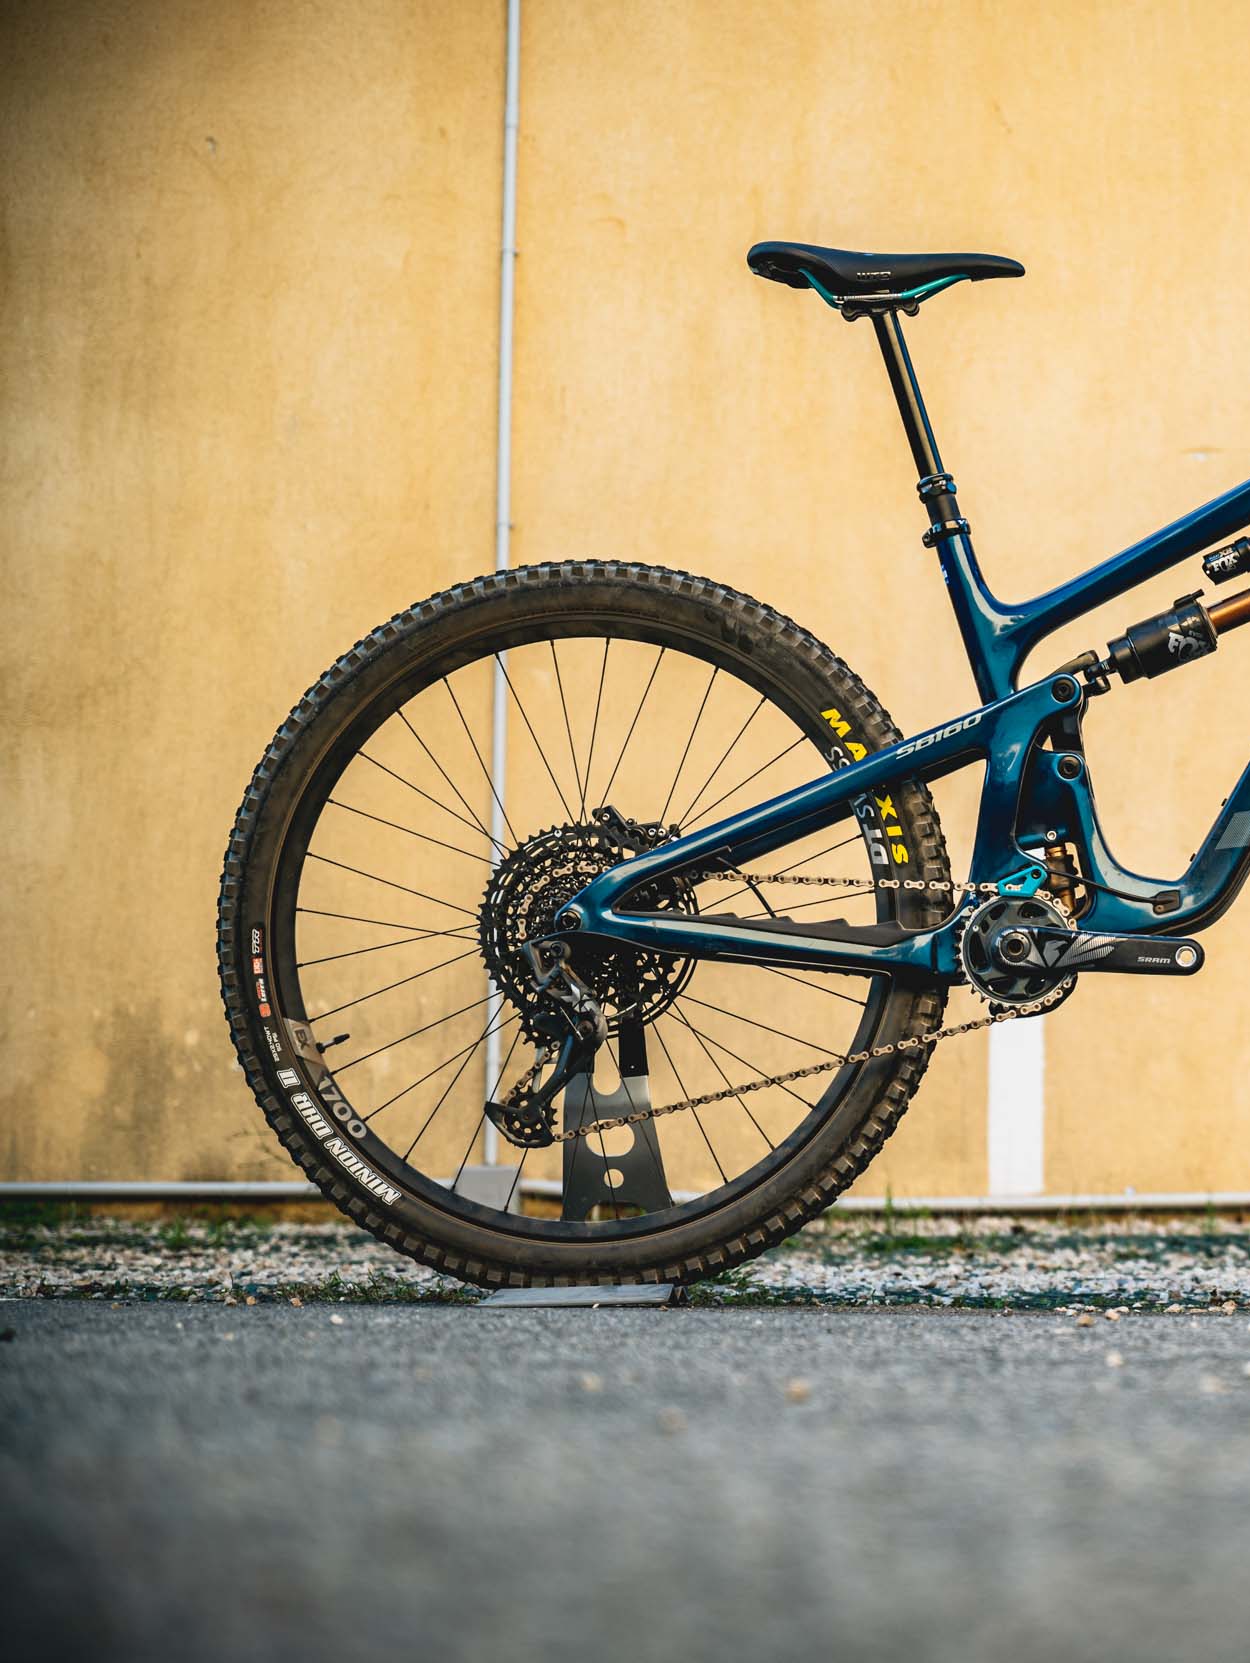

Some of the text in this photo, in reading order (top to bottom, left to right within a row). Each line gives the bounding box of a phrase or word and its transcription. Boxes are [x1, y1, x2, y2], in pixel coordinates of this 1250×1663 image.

[895, 712, 983, 760] SB160
[820, 707, 909, 864] MAXIS
[863, 823, 889, 865] DT
[1136, 956, 1171, 965] SRAM
[293, 1027, 311, 1052] EX
[315, 1073, 368, 1140] 1700
[276, 1067, 402, 1206] MINION DHR II
